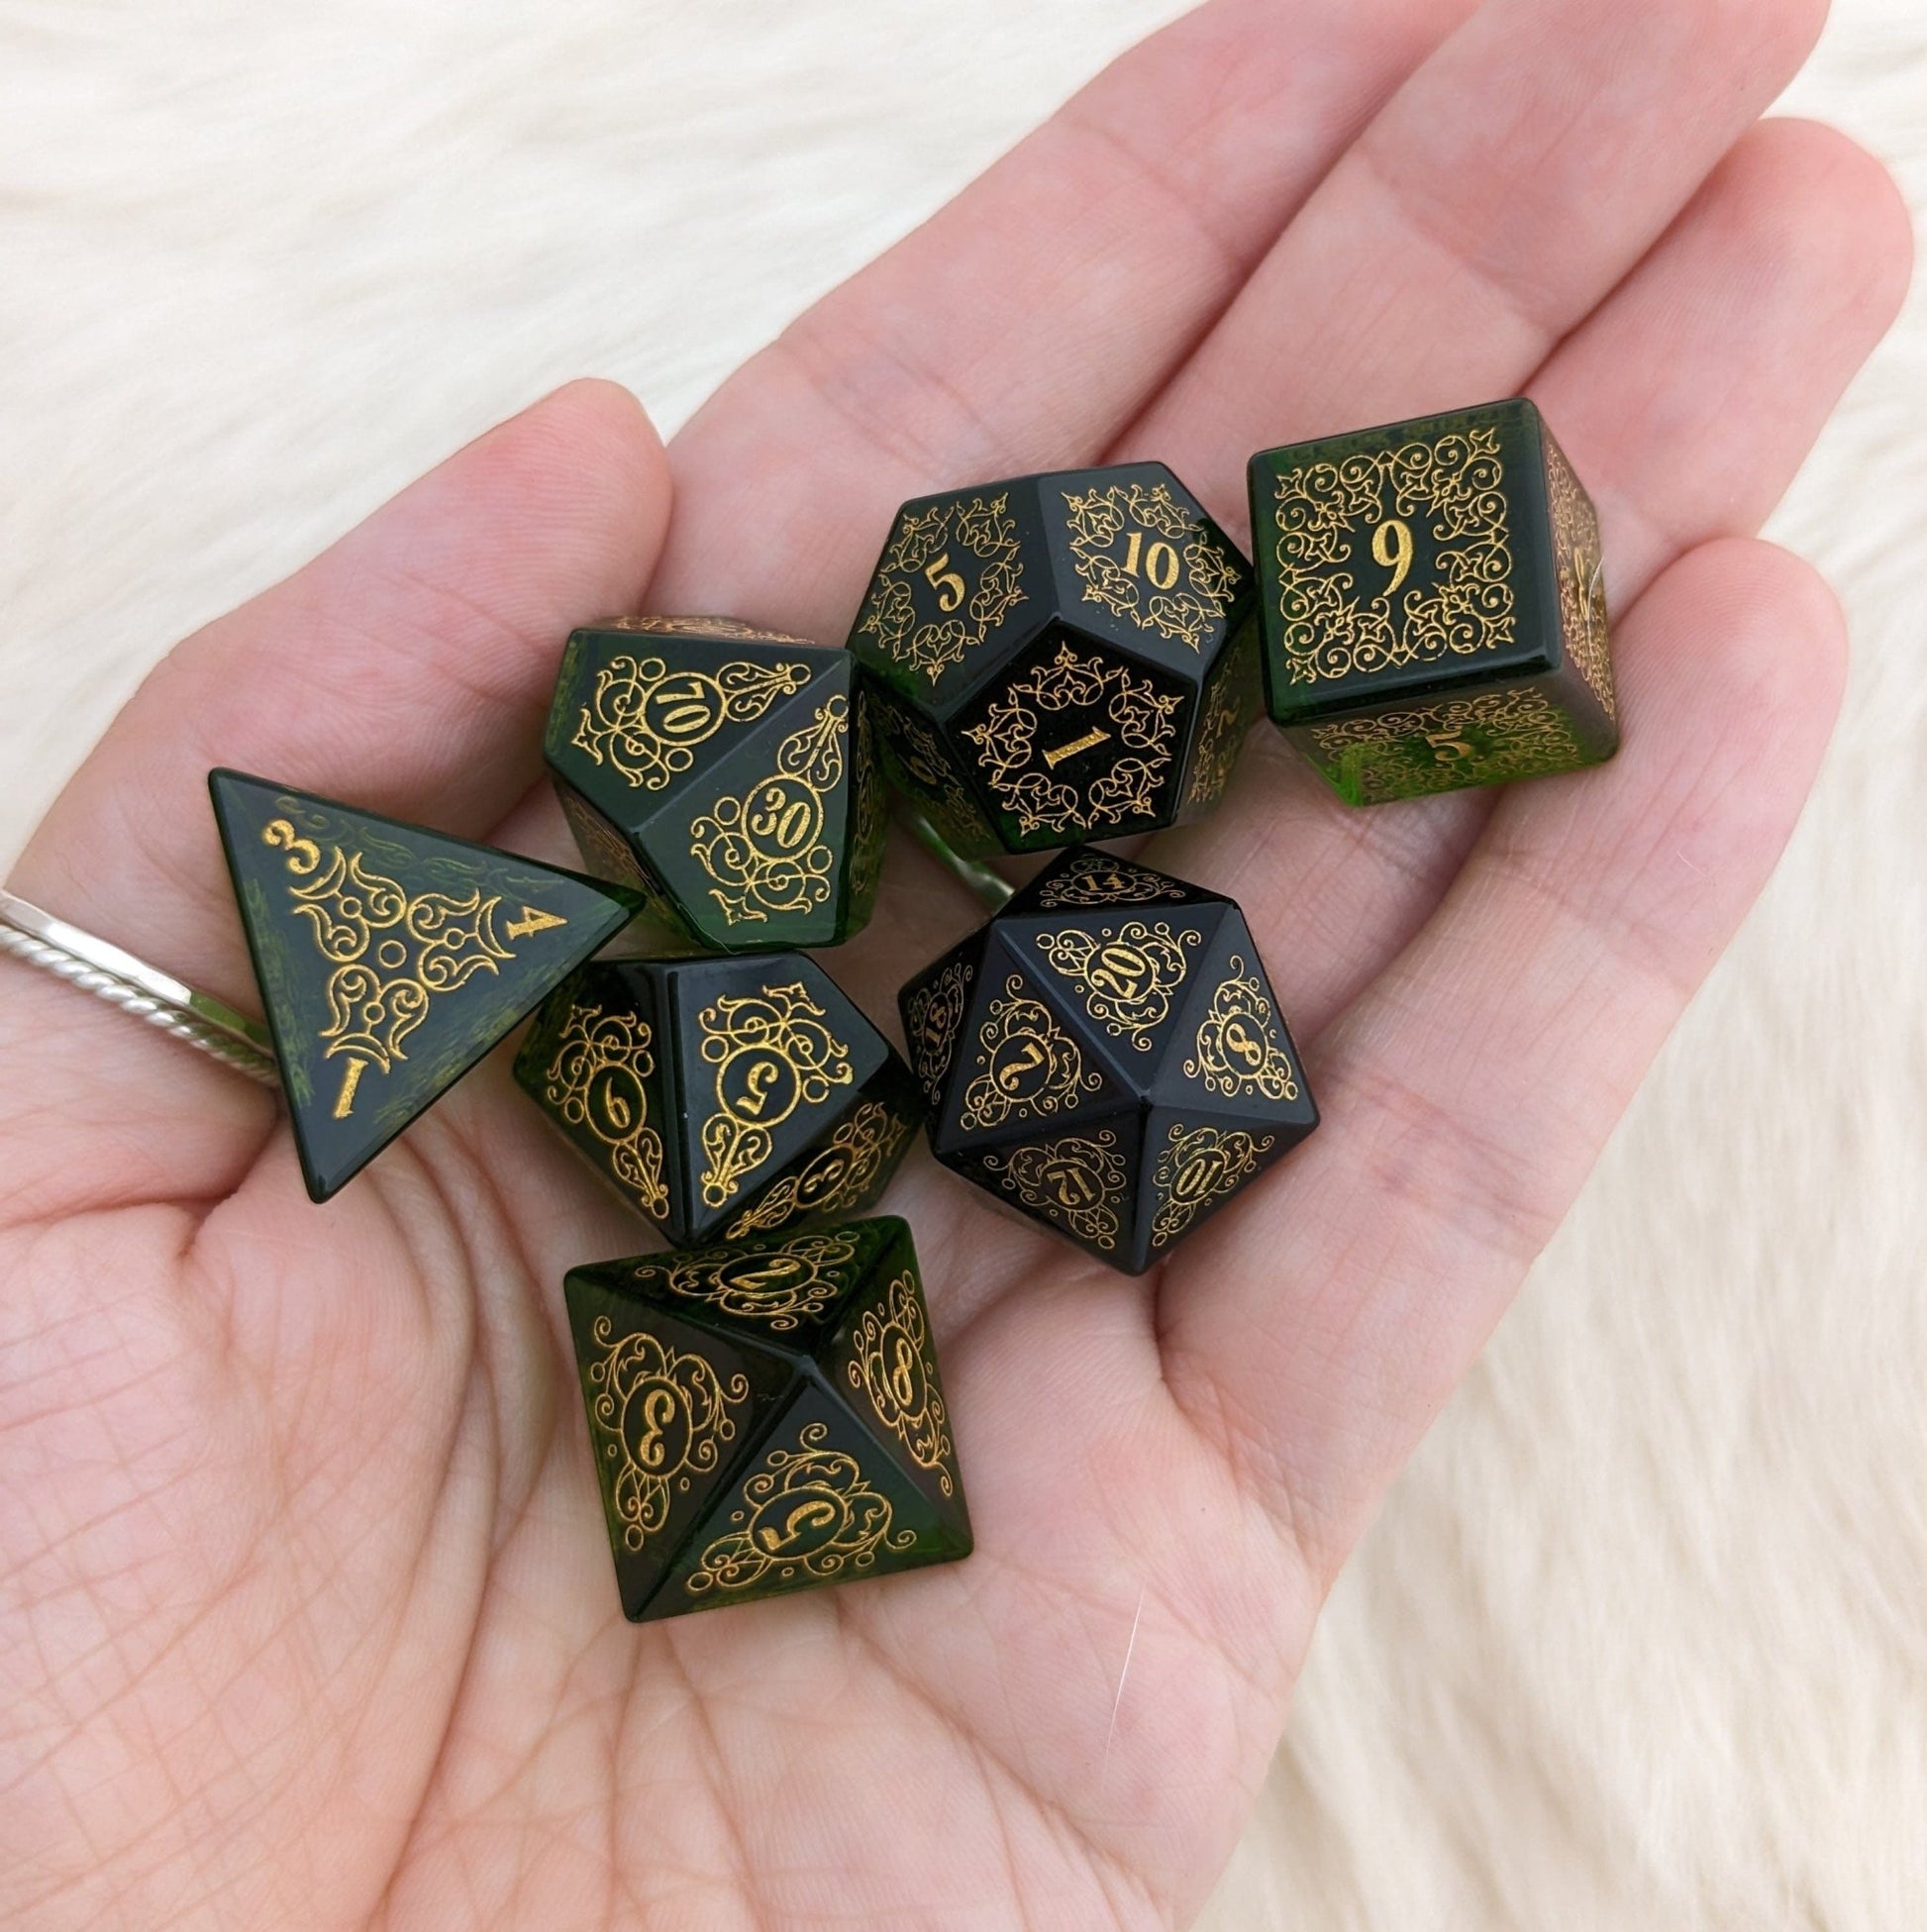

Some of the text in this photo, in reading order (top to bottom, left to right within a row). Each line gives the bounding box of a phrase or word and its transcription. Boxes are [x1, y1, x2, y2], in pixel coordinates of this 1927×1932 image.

[924, 552, 967, 613] 5
[1120, 531, 1181, 591] 10
[1041, 726, 1113, 771] 1
[1424, 731, 1473, 762] 5
[751, 786, 812, 850] 30
[260, 818, 322, 874] 3
[1085, 872, 1128, 892] 14
[505, 905, 570, 942] 4
[1090, 947, 1148, 1000] 20
[1226, 1022, 1263, 1066] 8
[332, 1056, 370, 1120] 1
[736, 1061, 780, 1116] 5
[1046, 1168, 1097, 1205] 12
[894, 1338, 915, 1407] 8
[638, 1388, 677, 1468] 3
[761, 1500, 837, 1551] 5
